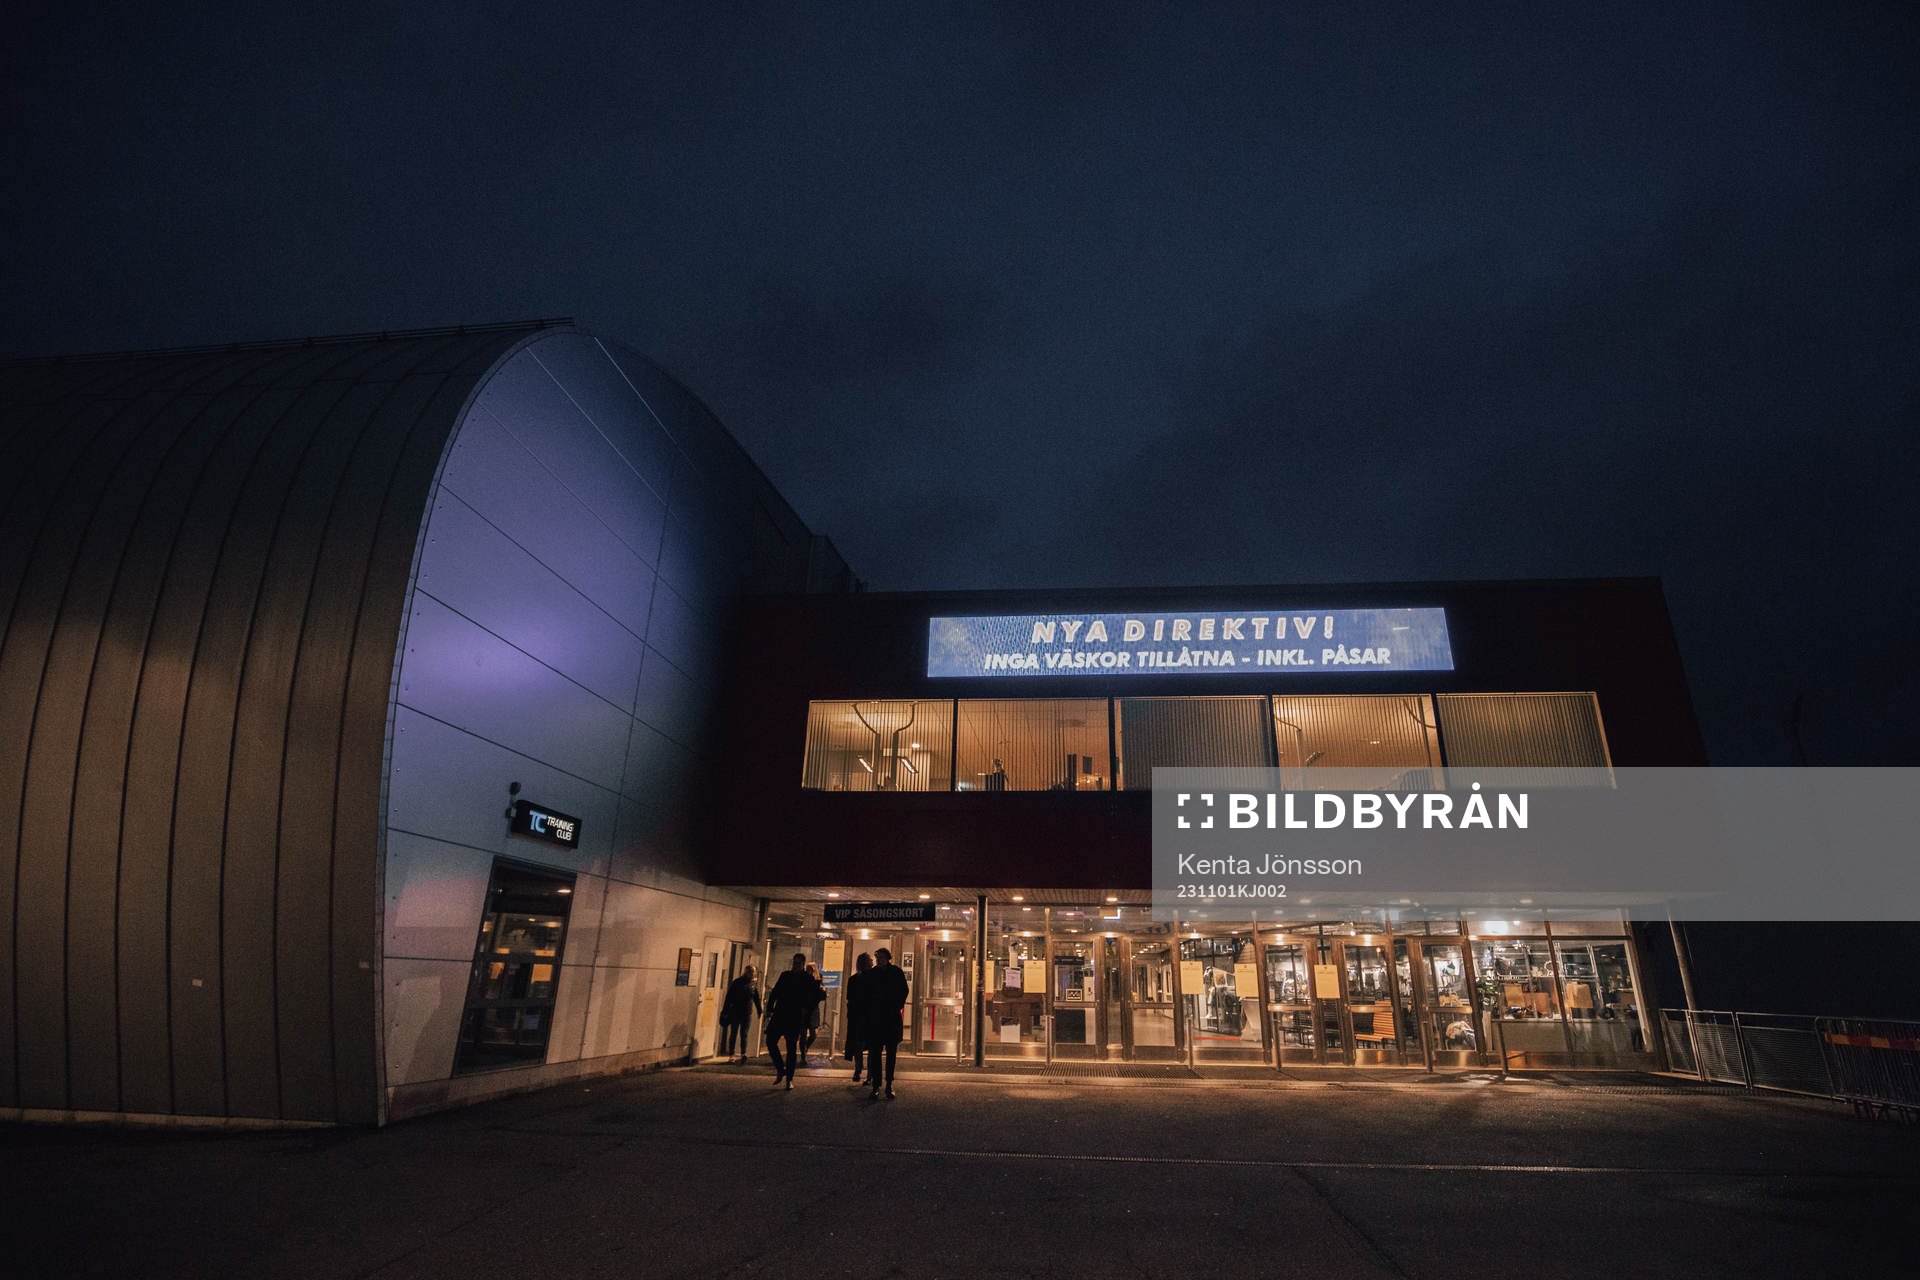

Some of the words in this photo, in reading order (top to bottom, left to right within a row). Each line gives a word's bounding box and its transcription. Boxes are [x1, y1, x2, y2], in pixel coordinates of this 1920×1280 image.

[1031, 620, 1108, 643] NYA
[1123, 616, 1334, 642] DIREKTIV!
[984, 653, 1040, 670] INGA
[1045, 649, 1131, 668] VÄSKOR
[1137, 646, 1236, 667] TILLÅTNA
[1257, 649, 1315, 666] INKL.
[1322, 643, 1391, 665] PÅSAR
[547, 816, 574, 831] TRAINING
[556, 829, 572, 841] CLUB
[835, 908, 851, 919] VIP
